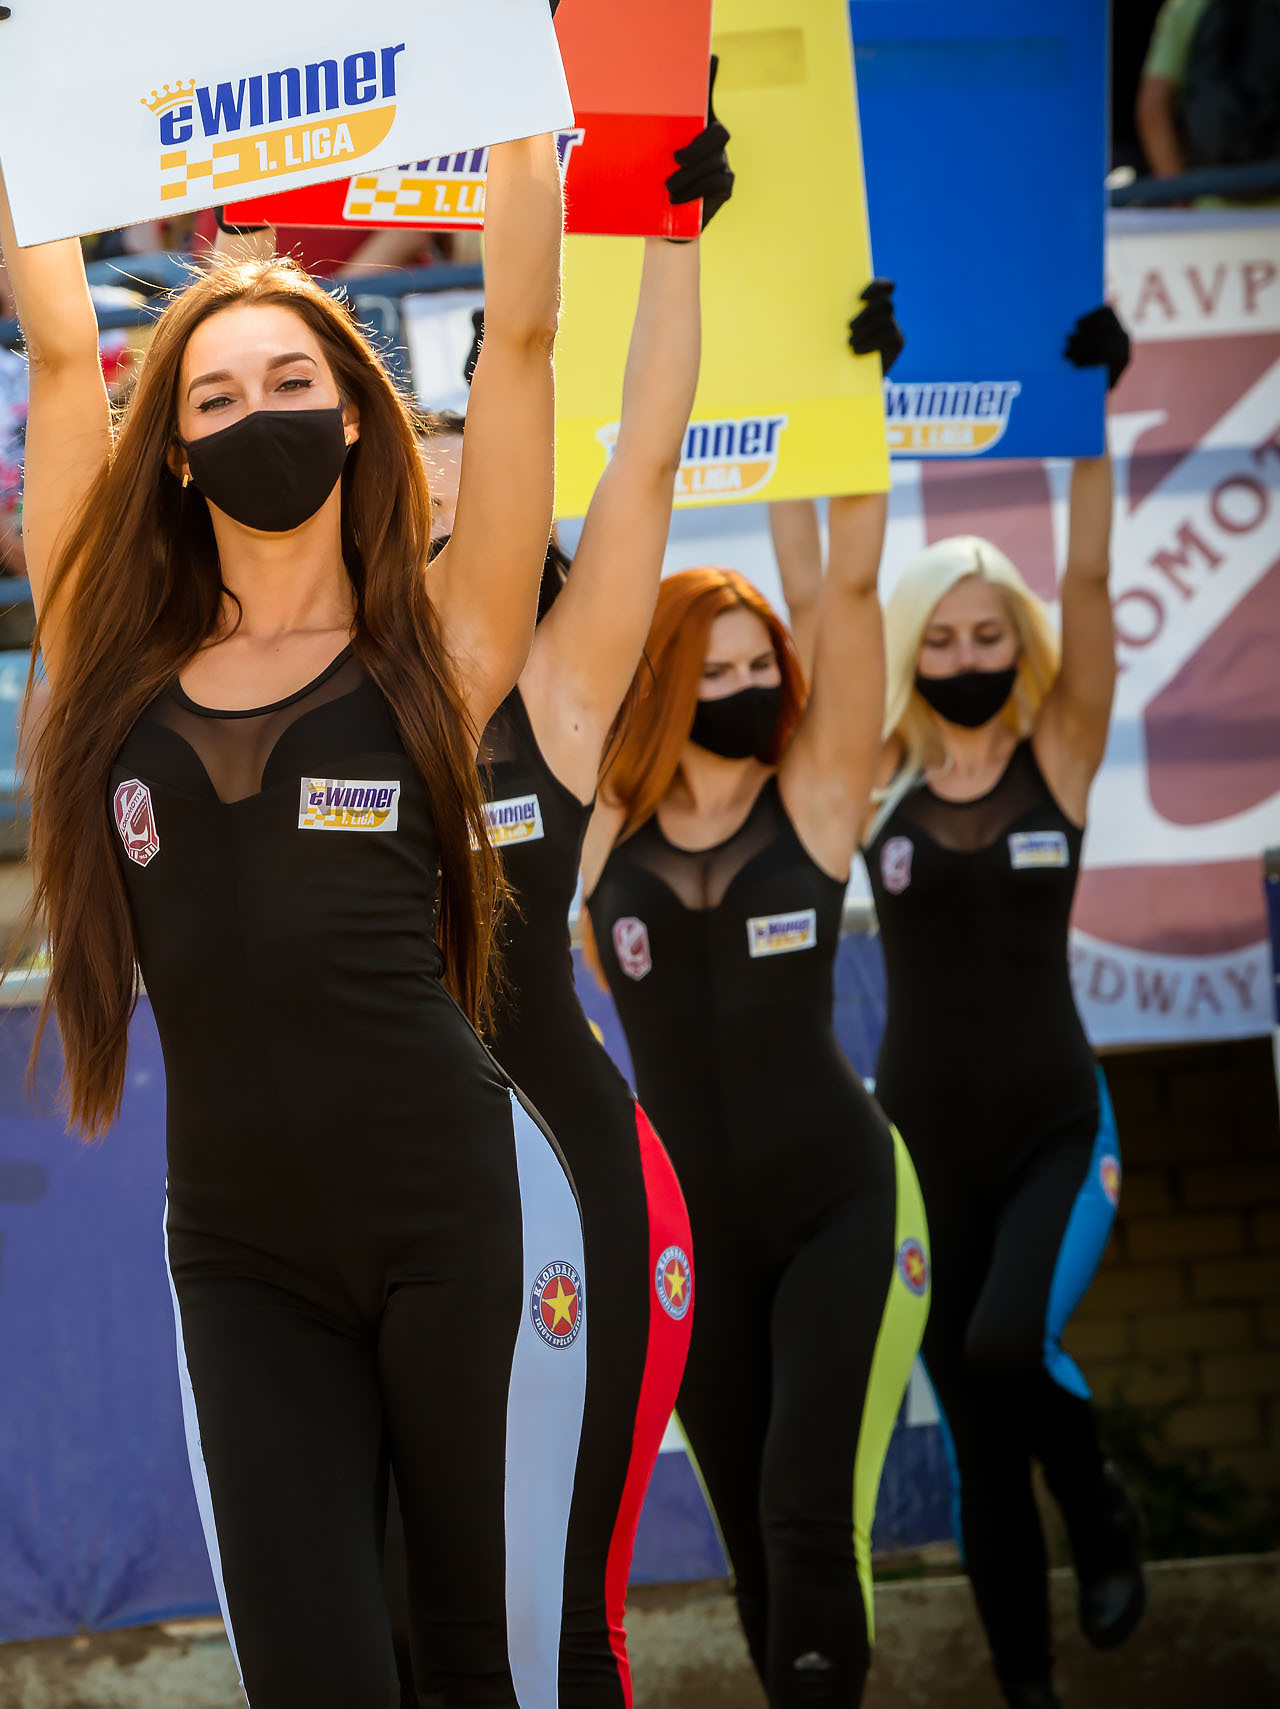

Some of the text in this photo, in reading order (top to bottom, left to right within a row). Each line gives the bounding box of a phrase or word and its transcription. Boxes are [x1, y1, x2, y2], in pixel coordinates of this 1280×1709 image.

[255, 140, 277, 172] 1.
[285, 122, 354, 167] LIGA
[434, 185, 485, 214] 1. LI
[1110, 259, 1278, 323] AVP
[885, 381, 1018, 417] winner
[1113, 425, 1280, 672] OMO
[351, 812, 374, 825] LIGA
[534, 1264, 580, 1297] KLONDAIKA
